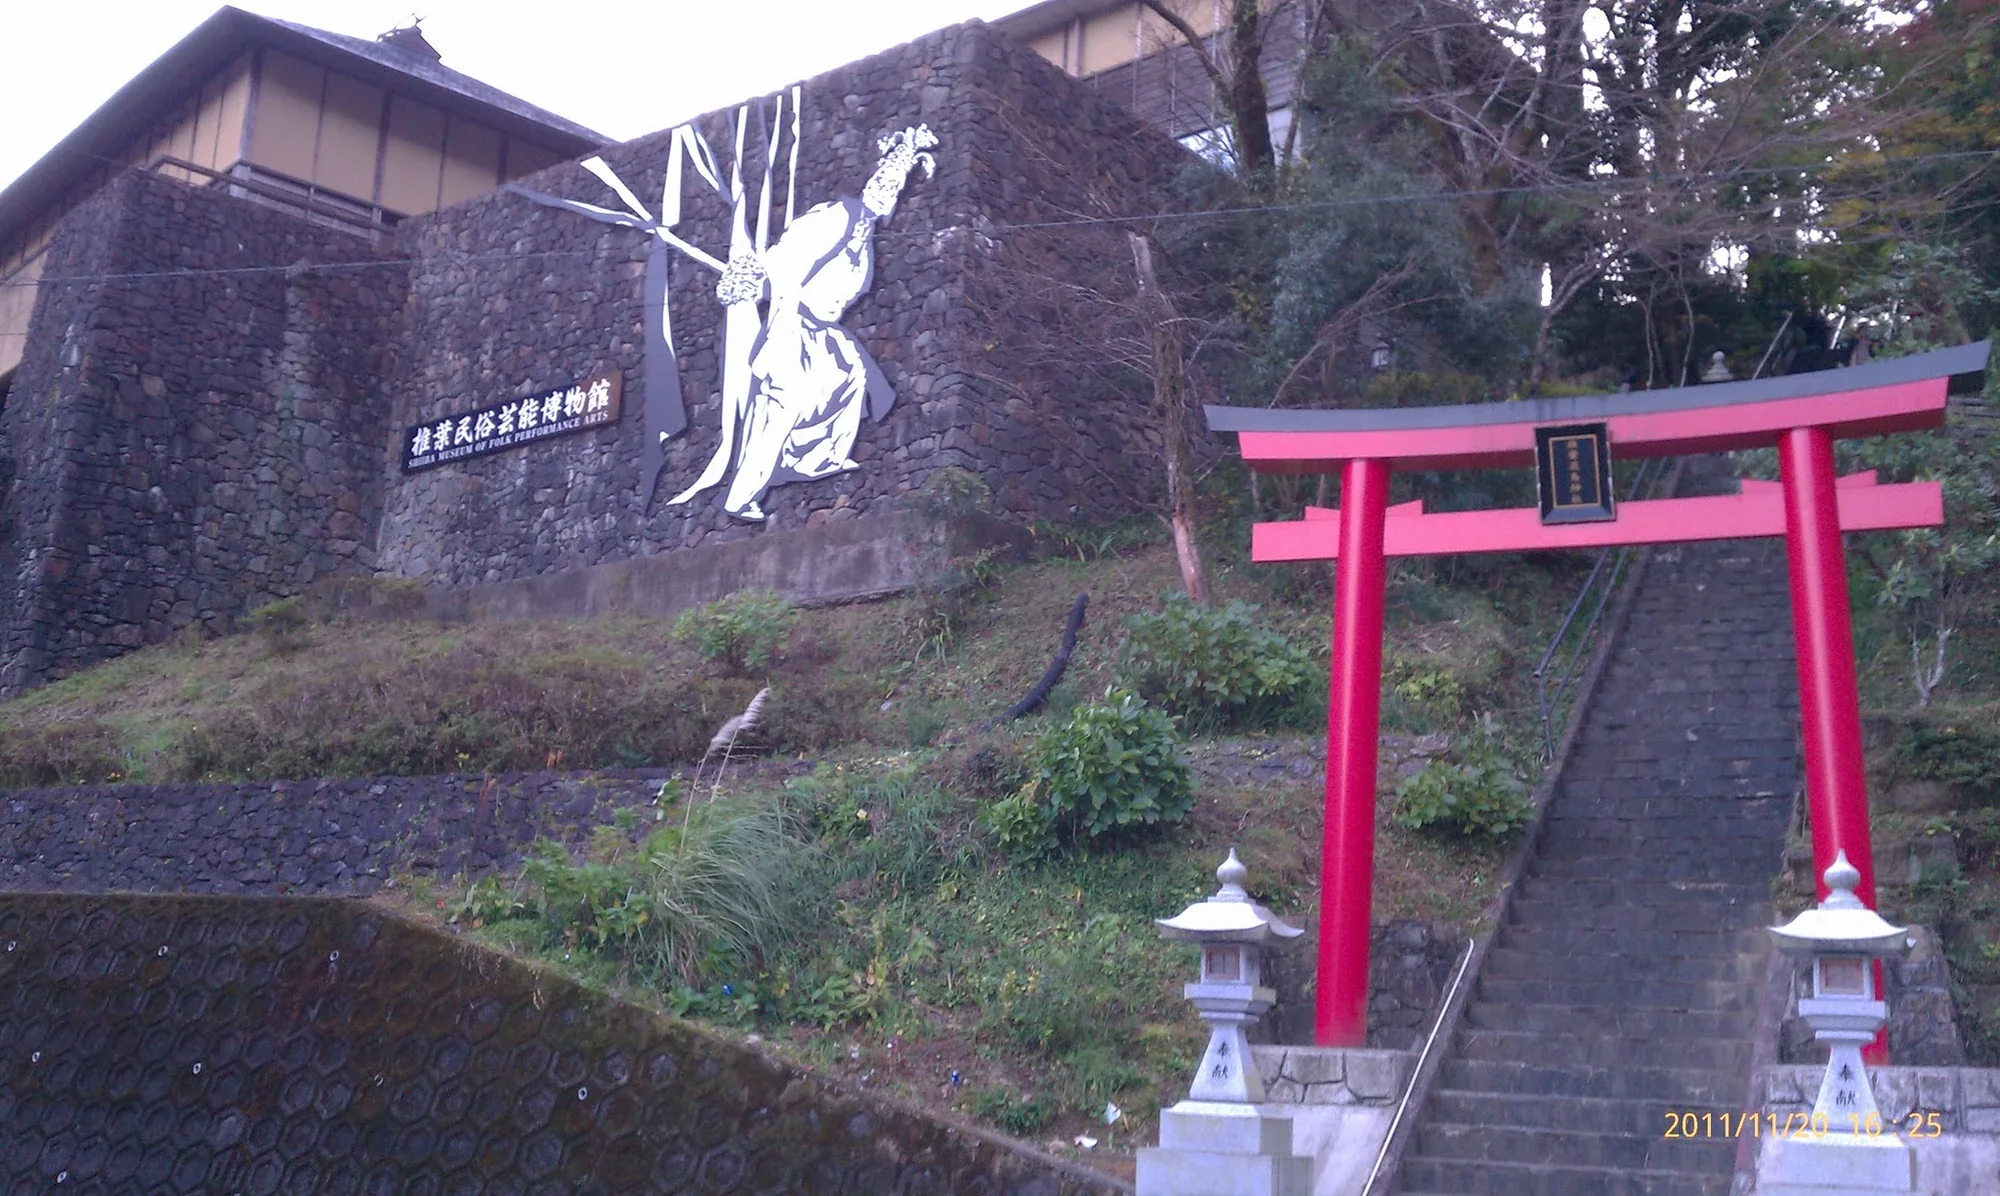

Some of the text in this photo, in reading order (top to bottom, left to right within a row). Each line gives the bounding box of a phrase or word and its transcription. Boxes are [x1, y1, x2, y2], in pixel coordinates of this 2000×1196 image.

[411, 378, 611, 456] 椎葉民俗芸能博物館
[438, 444, 473, 461] MUSEUM
[474, 440, 487, 452] OF
[488, 434, 512, 449] FOLK
[514, 417, 580, 443] PERFORMANCE
[583, 410, 608, 425] ARTS
